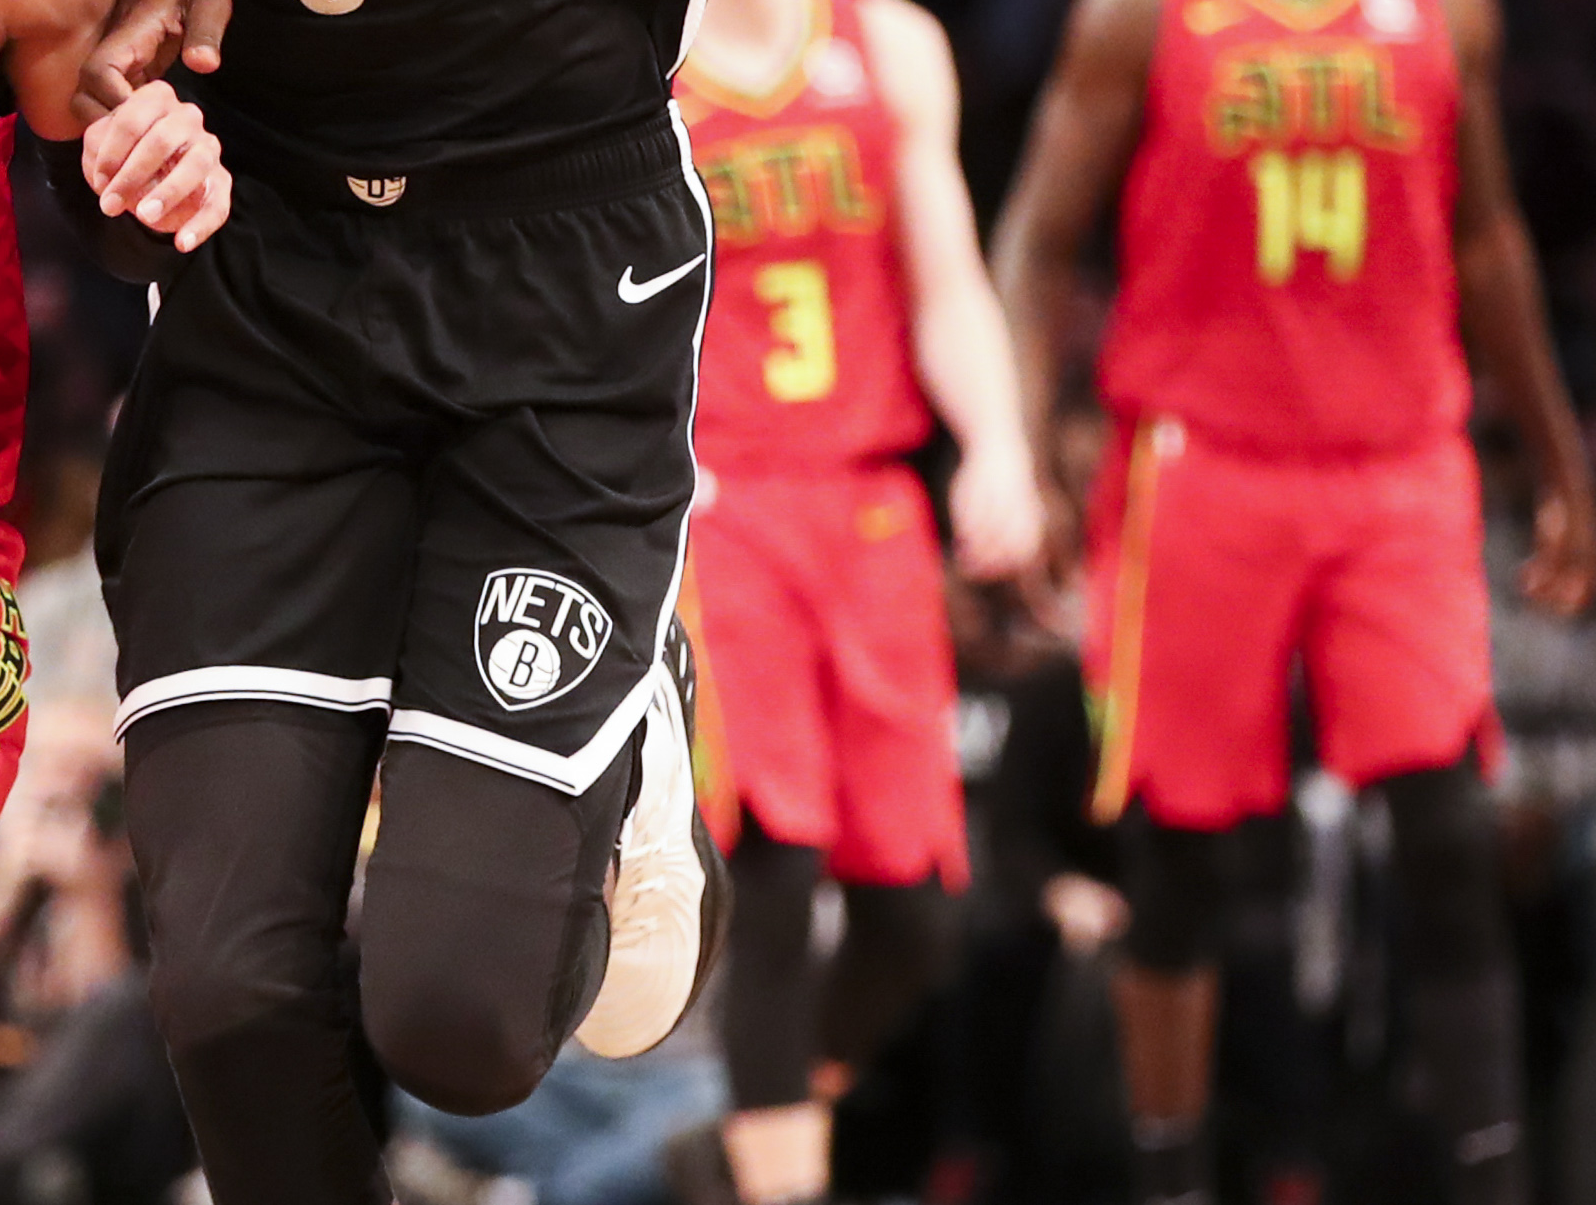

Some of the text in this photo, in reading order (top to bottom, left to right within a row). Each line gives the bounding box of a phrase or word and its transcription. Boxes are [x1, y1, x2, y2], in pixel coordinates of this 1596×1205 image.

[1250, 149, 1369, 285] 14
[754, 261, 837, 402] 3
[479, 574, 605, 661] NETS
[508, 640, 540, 688] B
